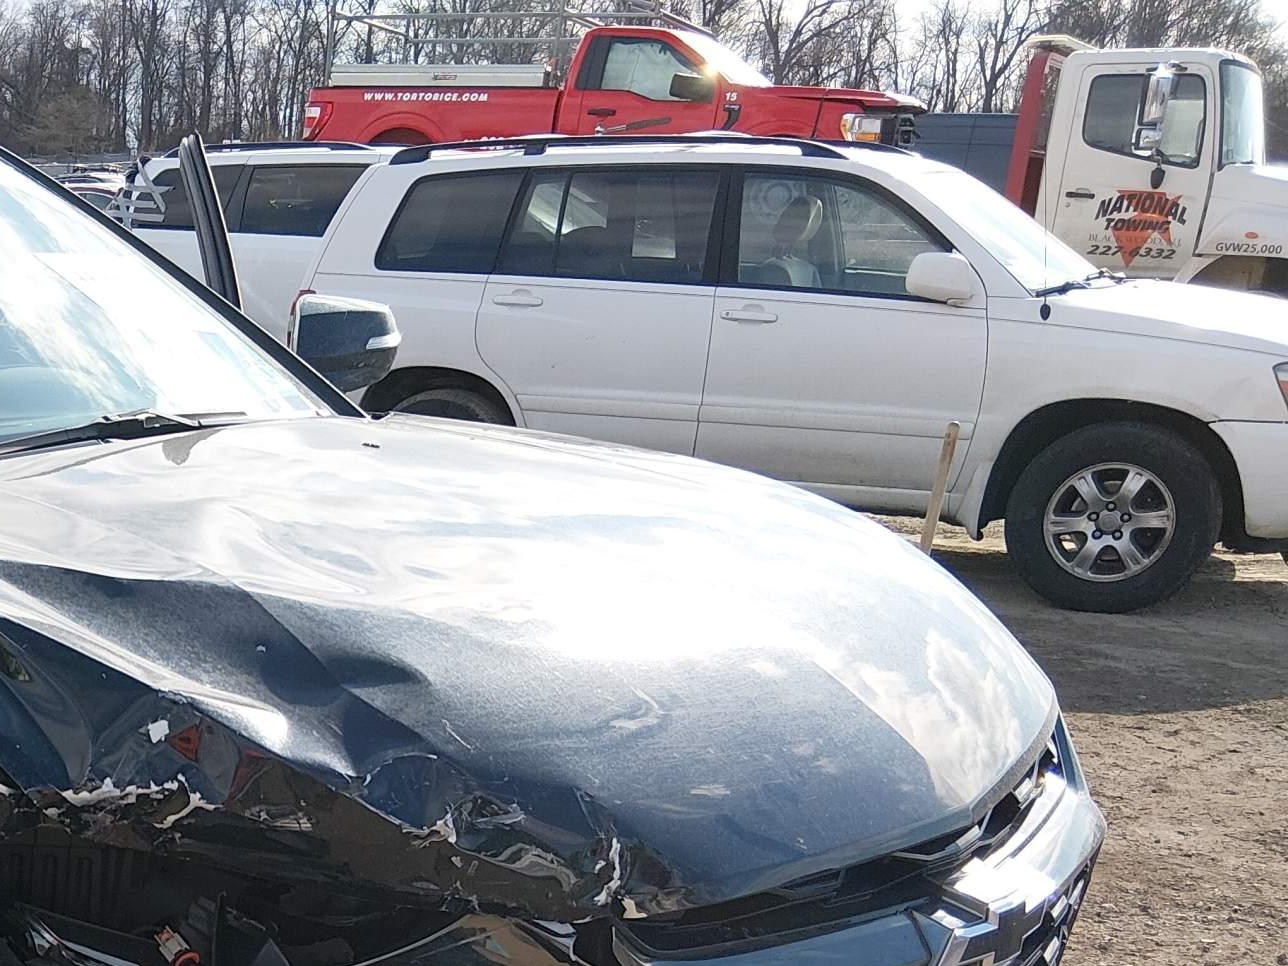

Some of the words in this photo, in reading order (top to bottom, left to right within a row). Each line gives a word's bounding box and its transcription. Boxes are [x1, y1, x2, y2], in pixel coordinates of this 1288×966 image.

[363, 92, 489, 102] WWW.TORTORICE.COM
[1094, 191, 1188, 225] NATIONAL
[1103, 217, 1172, 234] TOWING
[1087, 243, 1177, 260] 227-6332
[1215, 242, 1283, 255] GVW25,000
